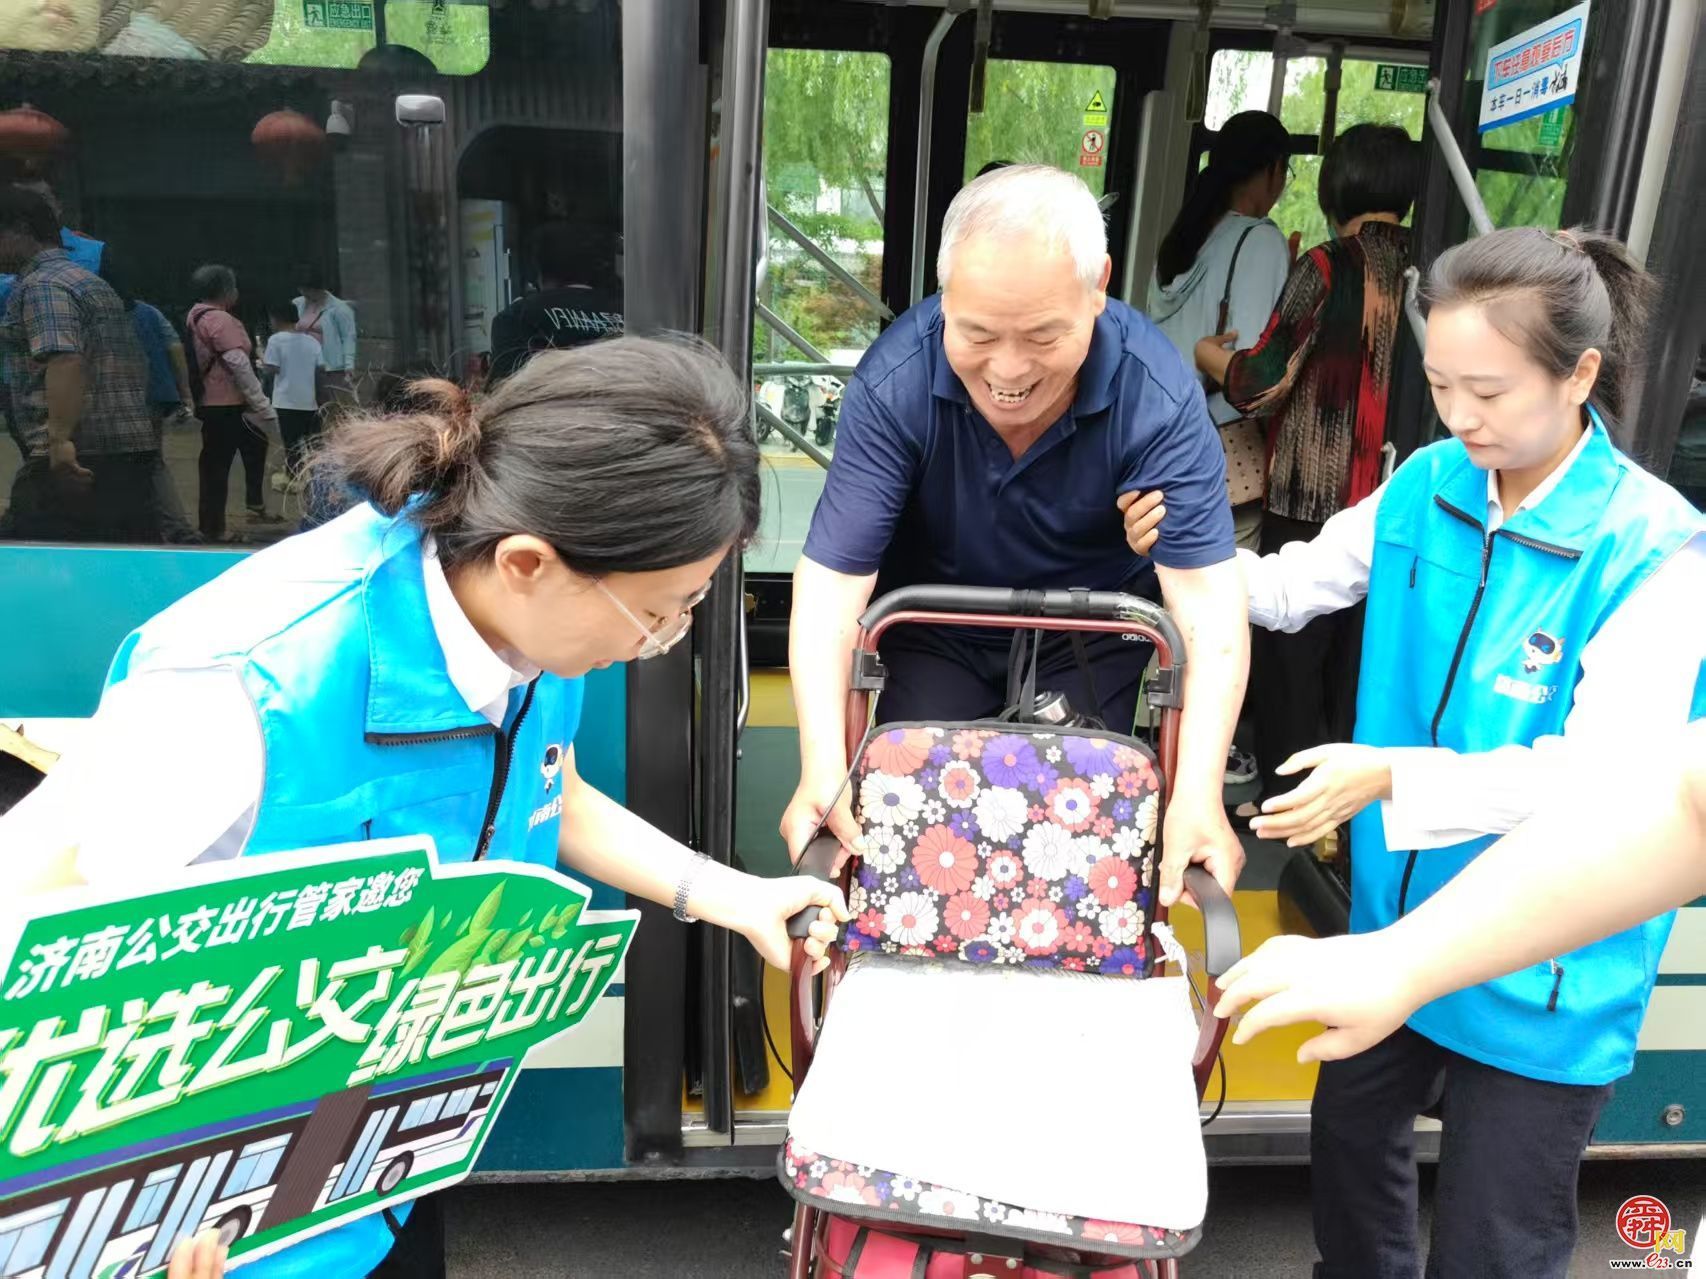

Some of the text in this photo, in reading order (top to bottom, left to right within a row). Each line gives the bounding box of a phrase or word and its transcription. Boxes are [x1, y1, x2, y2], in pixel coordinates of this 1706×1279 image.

[329, 3, 371, 19] 应急出口
[3, 867, 426, 1000] 济南公交出行管家邀您
[346, 933, 622, 1088] 绿色出行
